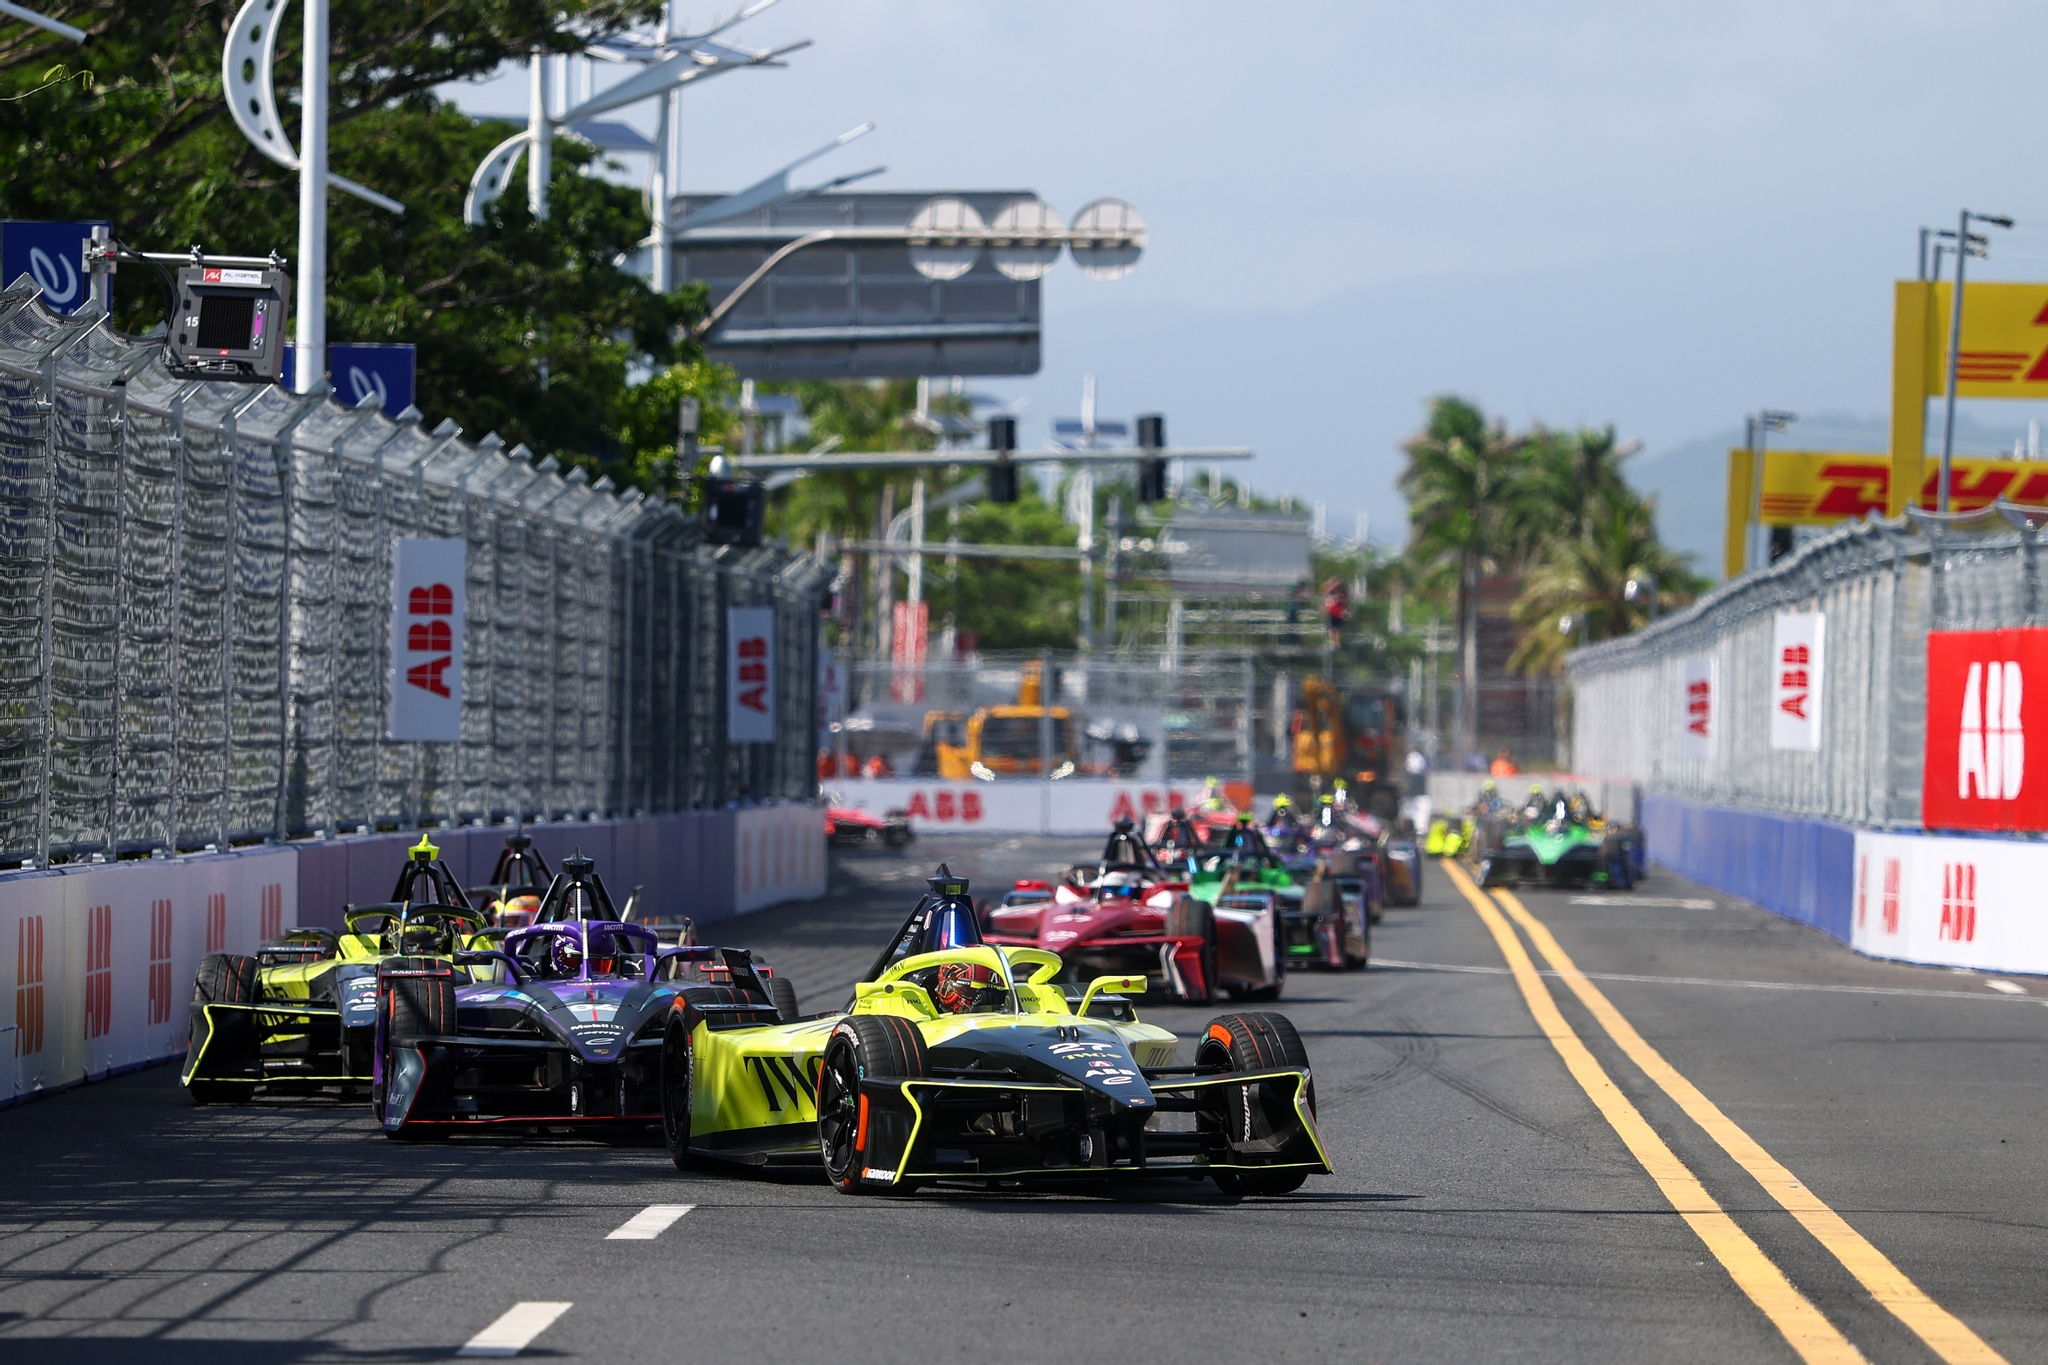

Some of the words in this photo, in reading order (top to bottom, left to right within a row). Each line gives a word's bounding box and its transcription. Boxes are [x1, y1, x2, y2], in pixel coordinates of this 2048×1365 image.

[185, 316, 199, 327] 15
[406, 582, 454, 700] ABB
[738, 635, 769, 714] ABB
[1688, 680, 1710, 739] ABB
[1780, 643, 1808, 720] ABB
[1957, 660, 2025, 801] ABB
[907, 790, 983, 823] ABB
[1939, 863, 1976, 942] ABB
[15, 915, 44, 1059] ABB
[84, 904, 112, 1041] ABB
[148, 899, 172, 1026] ABB
[1048, 1042, 1113, 1055] 27
[1085, 1068, 1136, 1078] ABB
